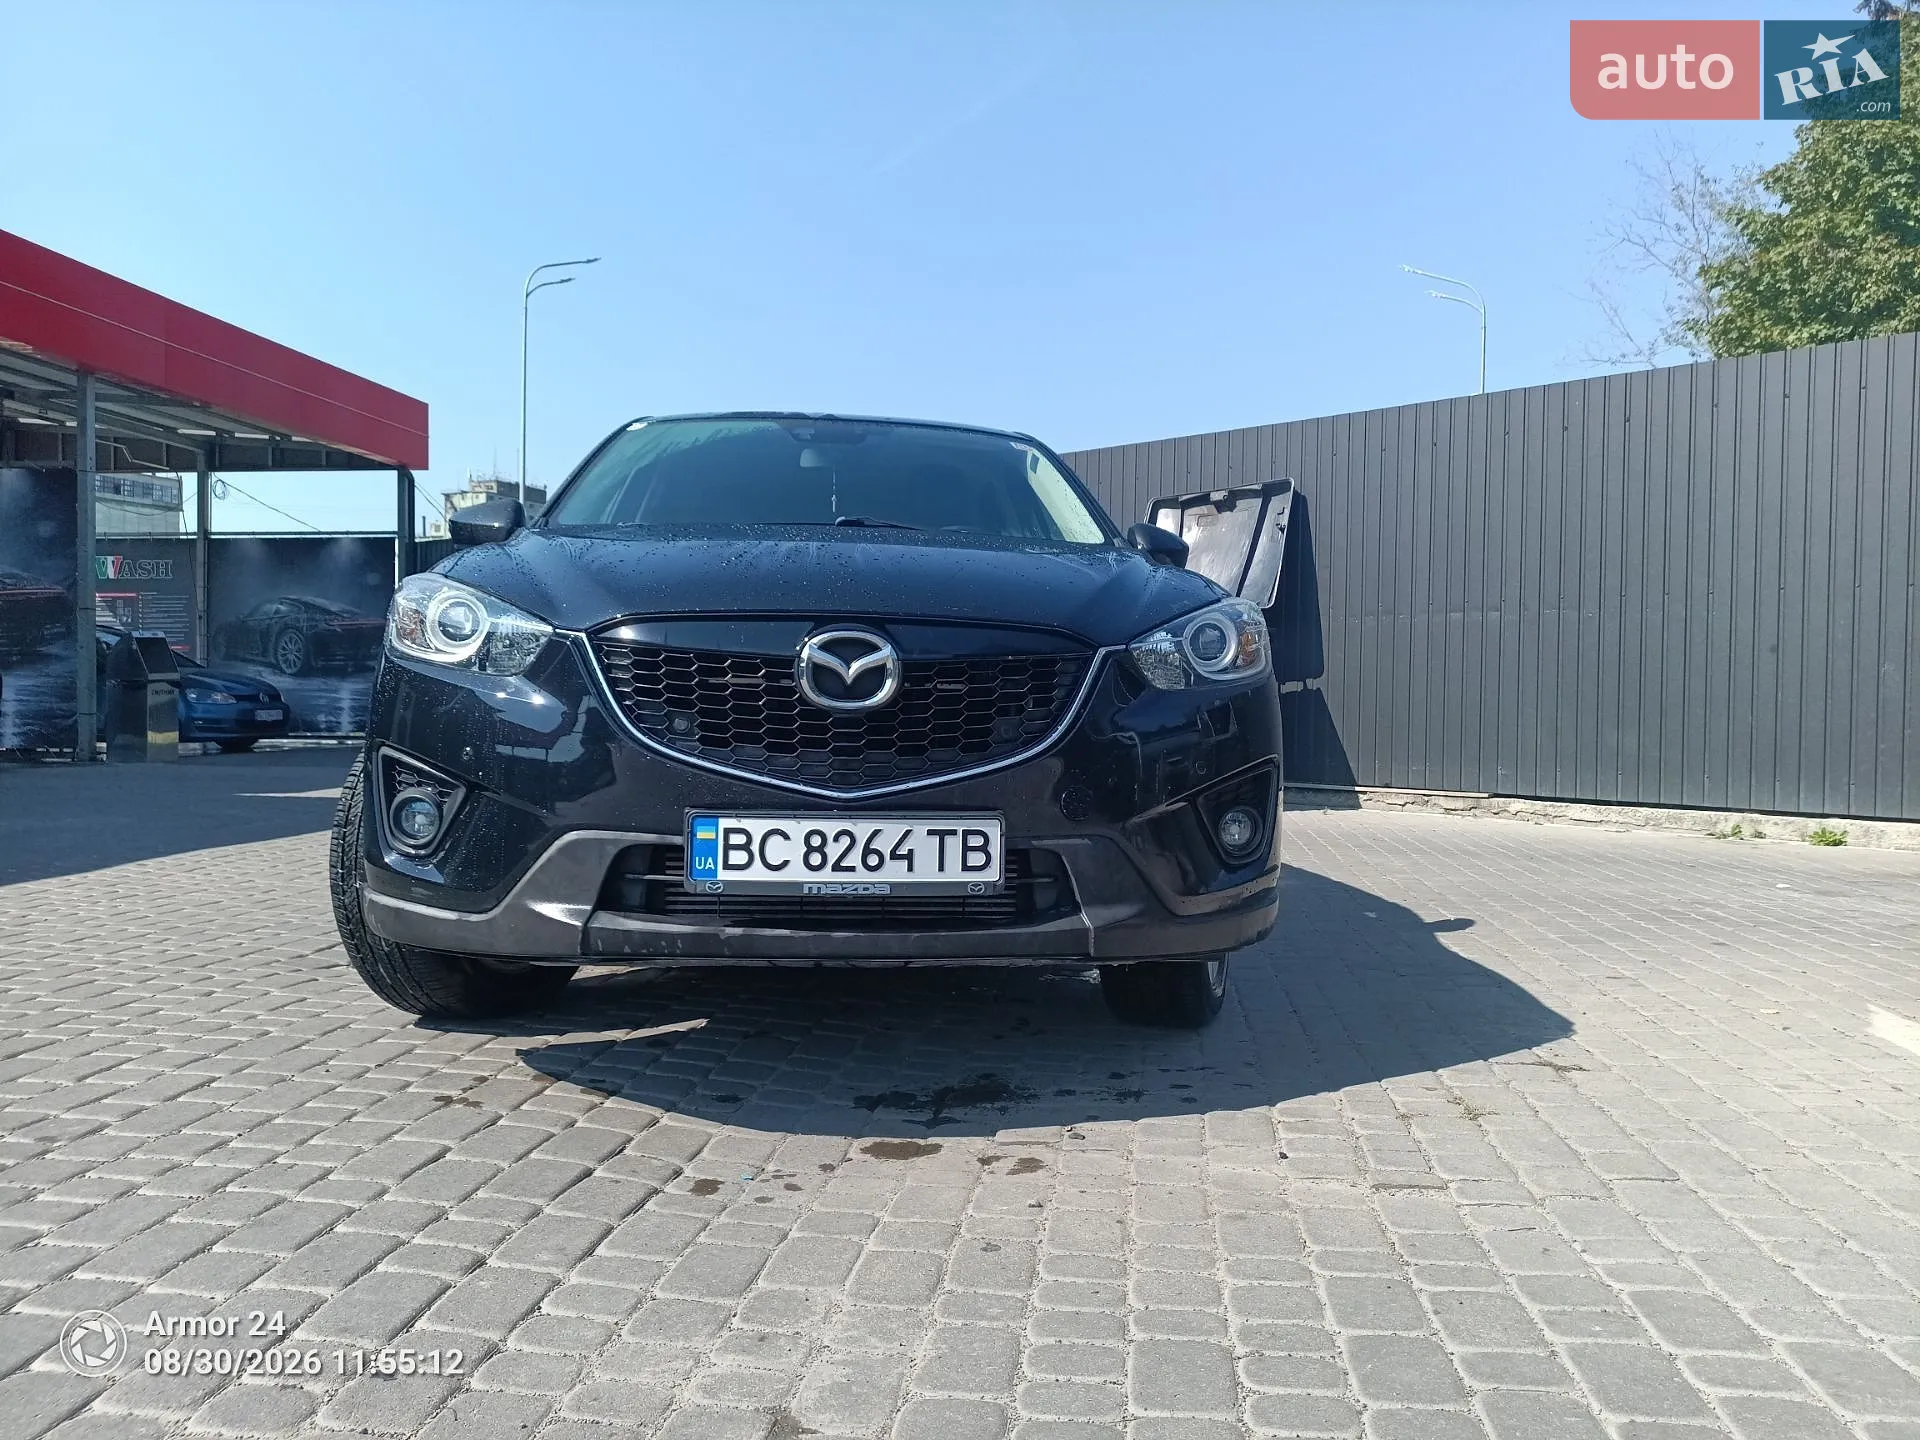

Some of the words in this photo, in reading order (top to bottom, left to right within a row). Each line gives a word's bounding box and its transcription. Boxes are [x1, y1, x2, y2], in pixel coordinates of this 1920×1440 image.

[96, 555, 173, 580] WASH
[695, 855, 715, 870] UA
[722, 827, 791, 873] BC
[802, 828, 914, 873] 8264
[927, 828, 992, 873] TB
